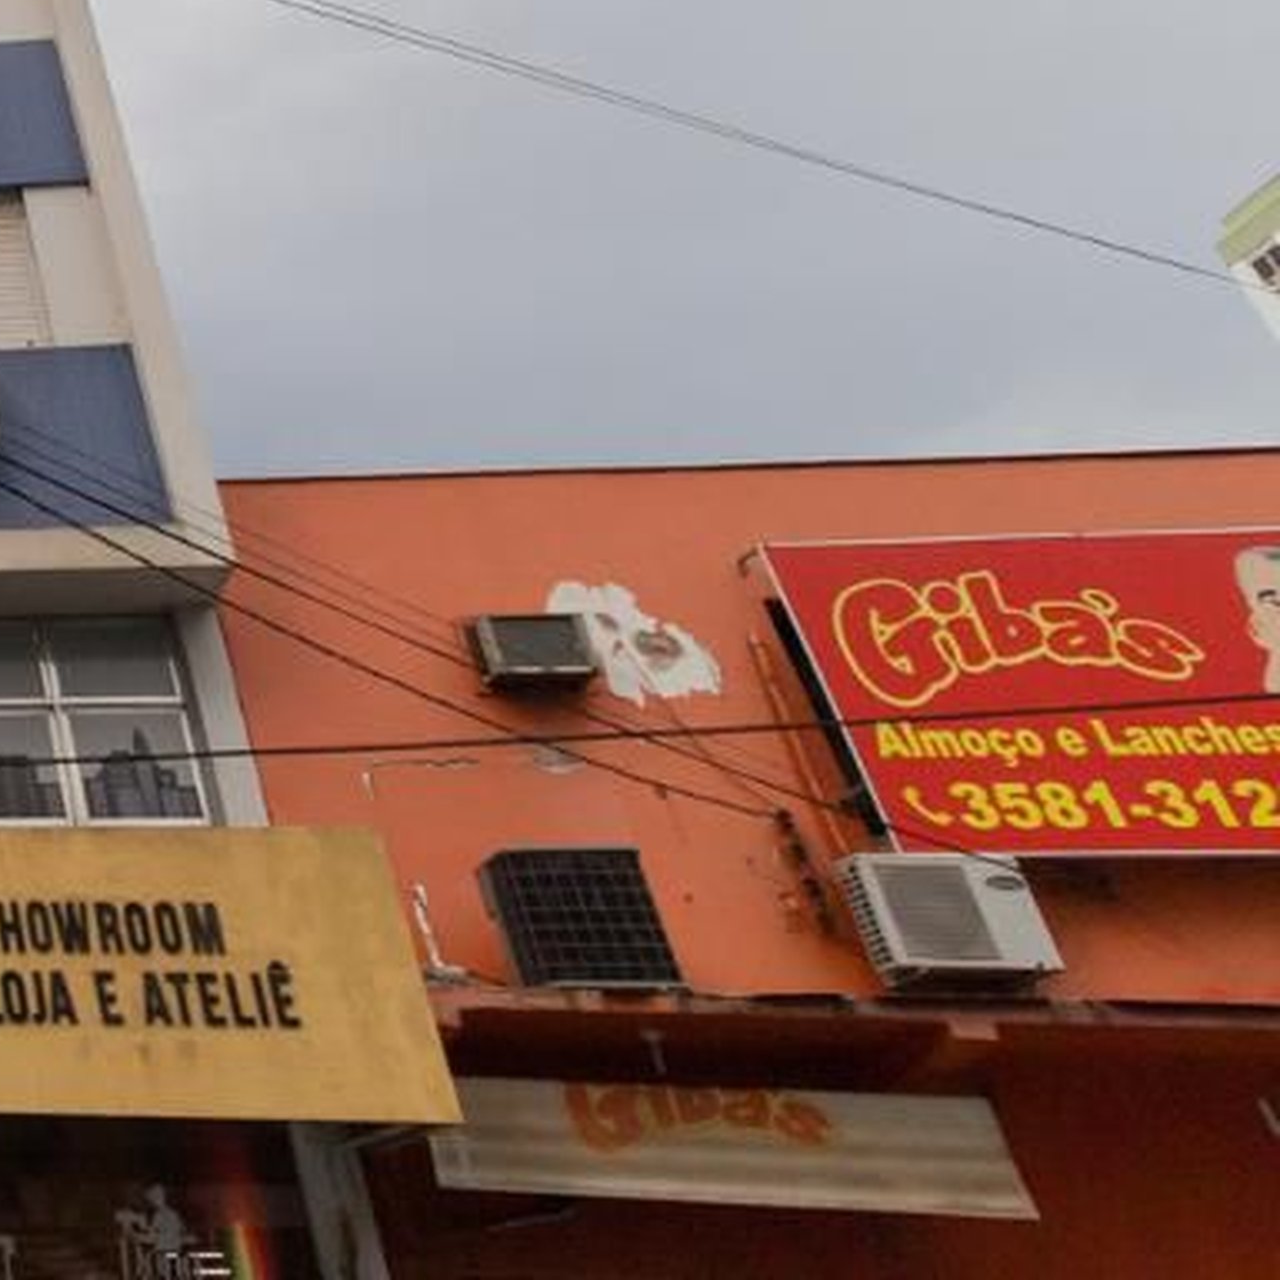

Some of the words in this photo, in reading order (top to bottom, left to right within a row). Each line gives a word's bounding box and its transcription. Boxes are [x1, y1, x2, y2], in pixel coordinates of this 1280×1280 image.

[876, 721, 1045, 768] Almoço
[1056, 726, 1088, 756] e
[1090, 716, 1280, 756] Lanches
[948, 779, 1280, 830] 3581-312
[94, 972, 125, 1026] E
[144, 960, 302, 1028] ATELIÊ
